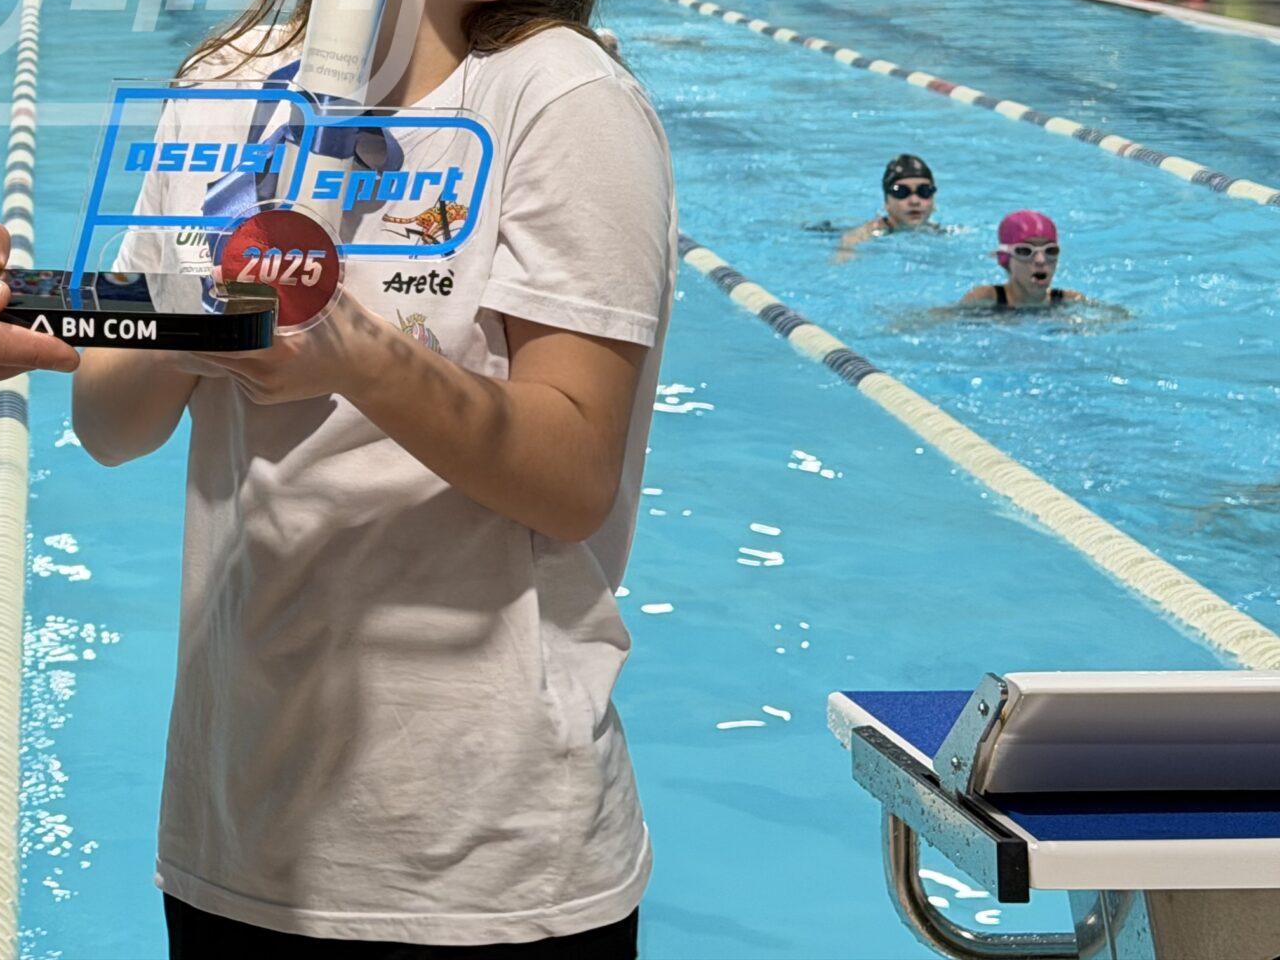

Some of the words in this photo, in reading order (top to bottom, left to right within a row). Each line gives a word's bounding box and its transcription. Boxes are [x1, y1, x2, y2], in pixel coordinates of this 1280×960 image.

[125, 142, 286, 173] assisi
[312, 166, 463, 211] sport
[236, 246, 326, 287] 2025
[62, 317, 95, 338] BN
[103, 319, 157, 340] COM
